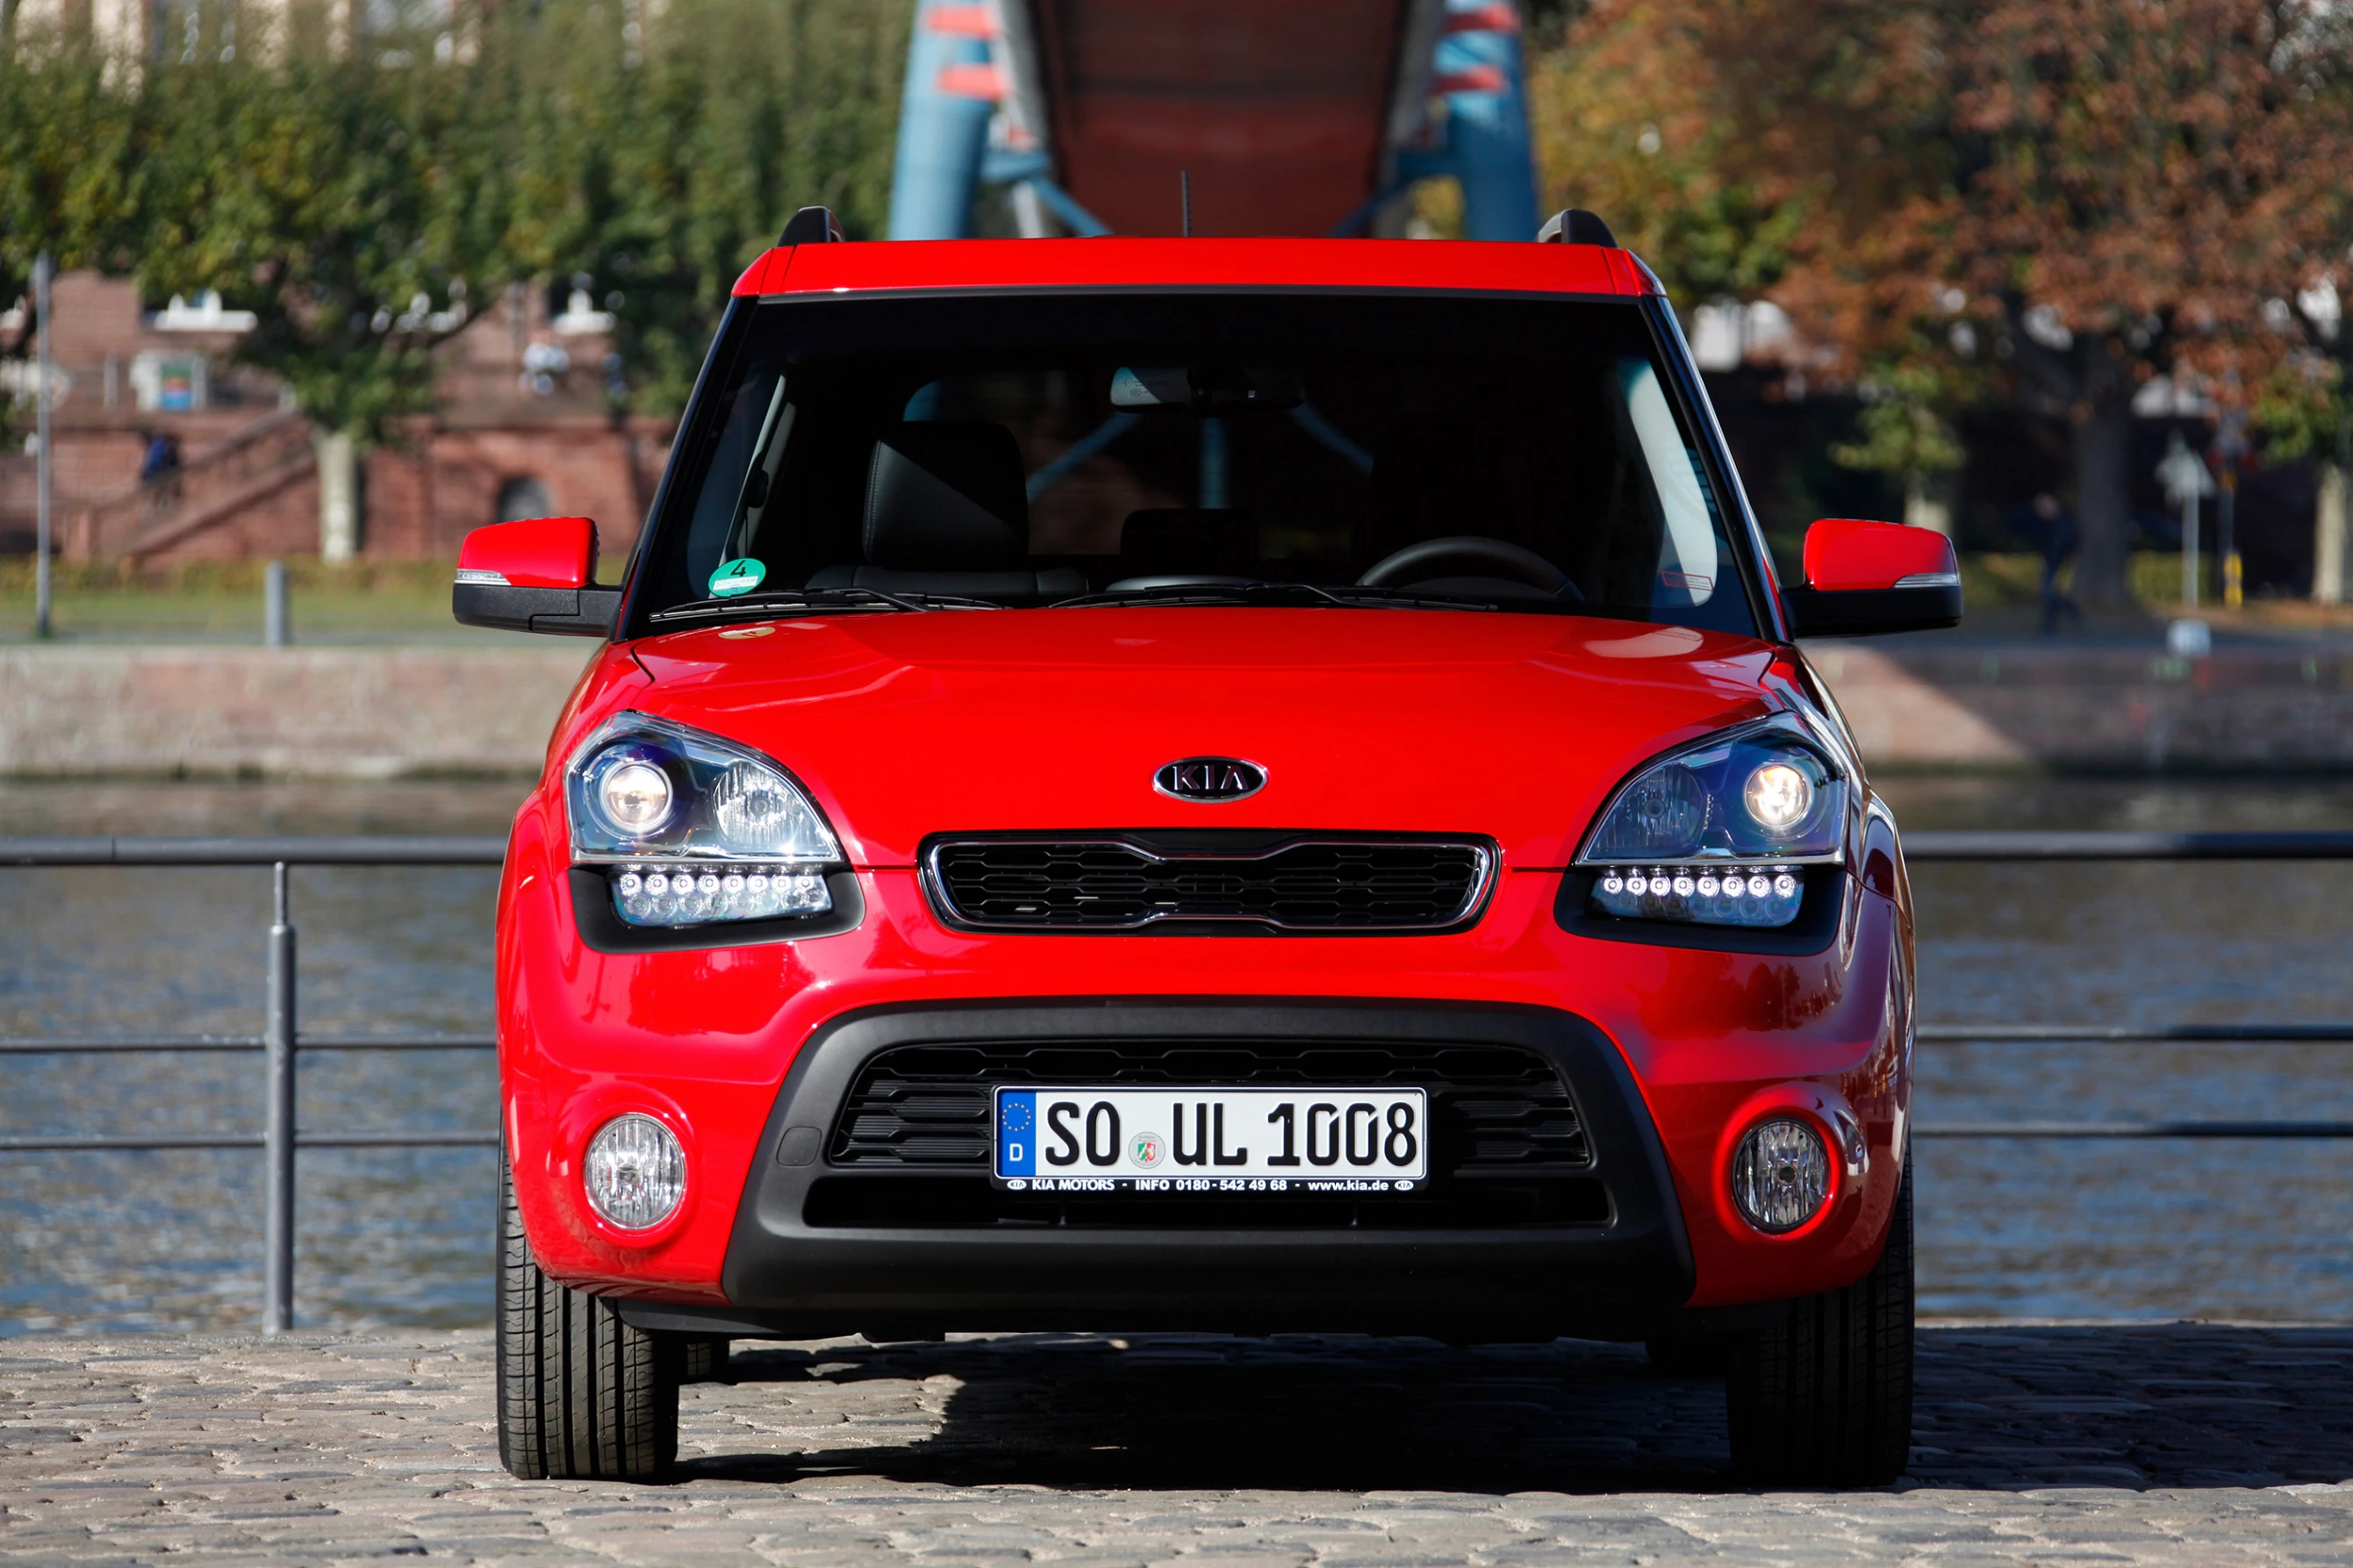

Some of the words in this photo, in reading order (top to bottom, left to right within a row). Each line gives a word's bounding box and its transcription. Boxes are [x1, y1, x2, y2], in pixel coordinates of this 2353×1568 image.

[729, 559, 747, 577] 4
[1172, 764, 1249, 791] KIA
[1045, 1101, 1121, 1167] SO
[1173, 1102, 1247, 1167] UL
[1267, 1102, 1417, 1167] 1008
[1009, 1142, 1023, 1162] D
[1032, 1179, 1055, 1191] KIA
[1058, 1179, 1115, 1191] MOTORS
[1135, 1179, 1170, 1191] INFO
[1248, 1179, 1266, 1191] 49
[1270, 1179, 1288, 1191] 68
[1308, 1179, 1389, 1191] www.kia.de
